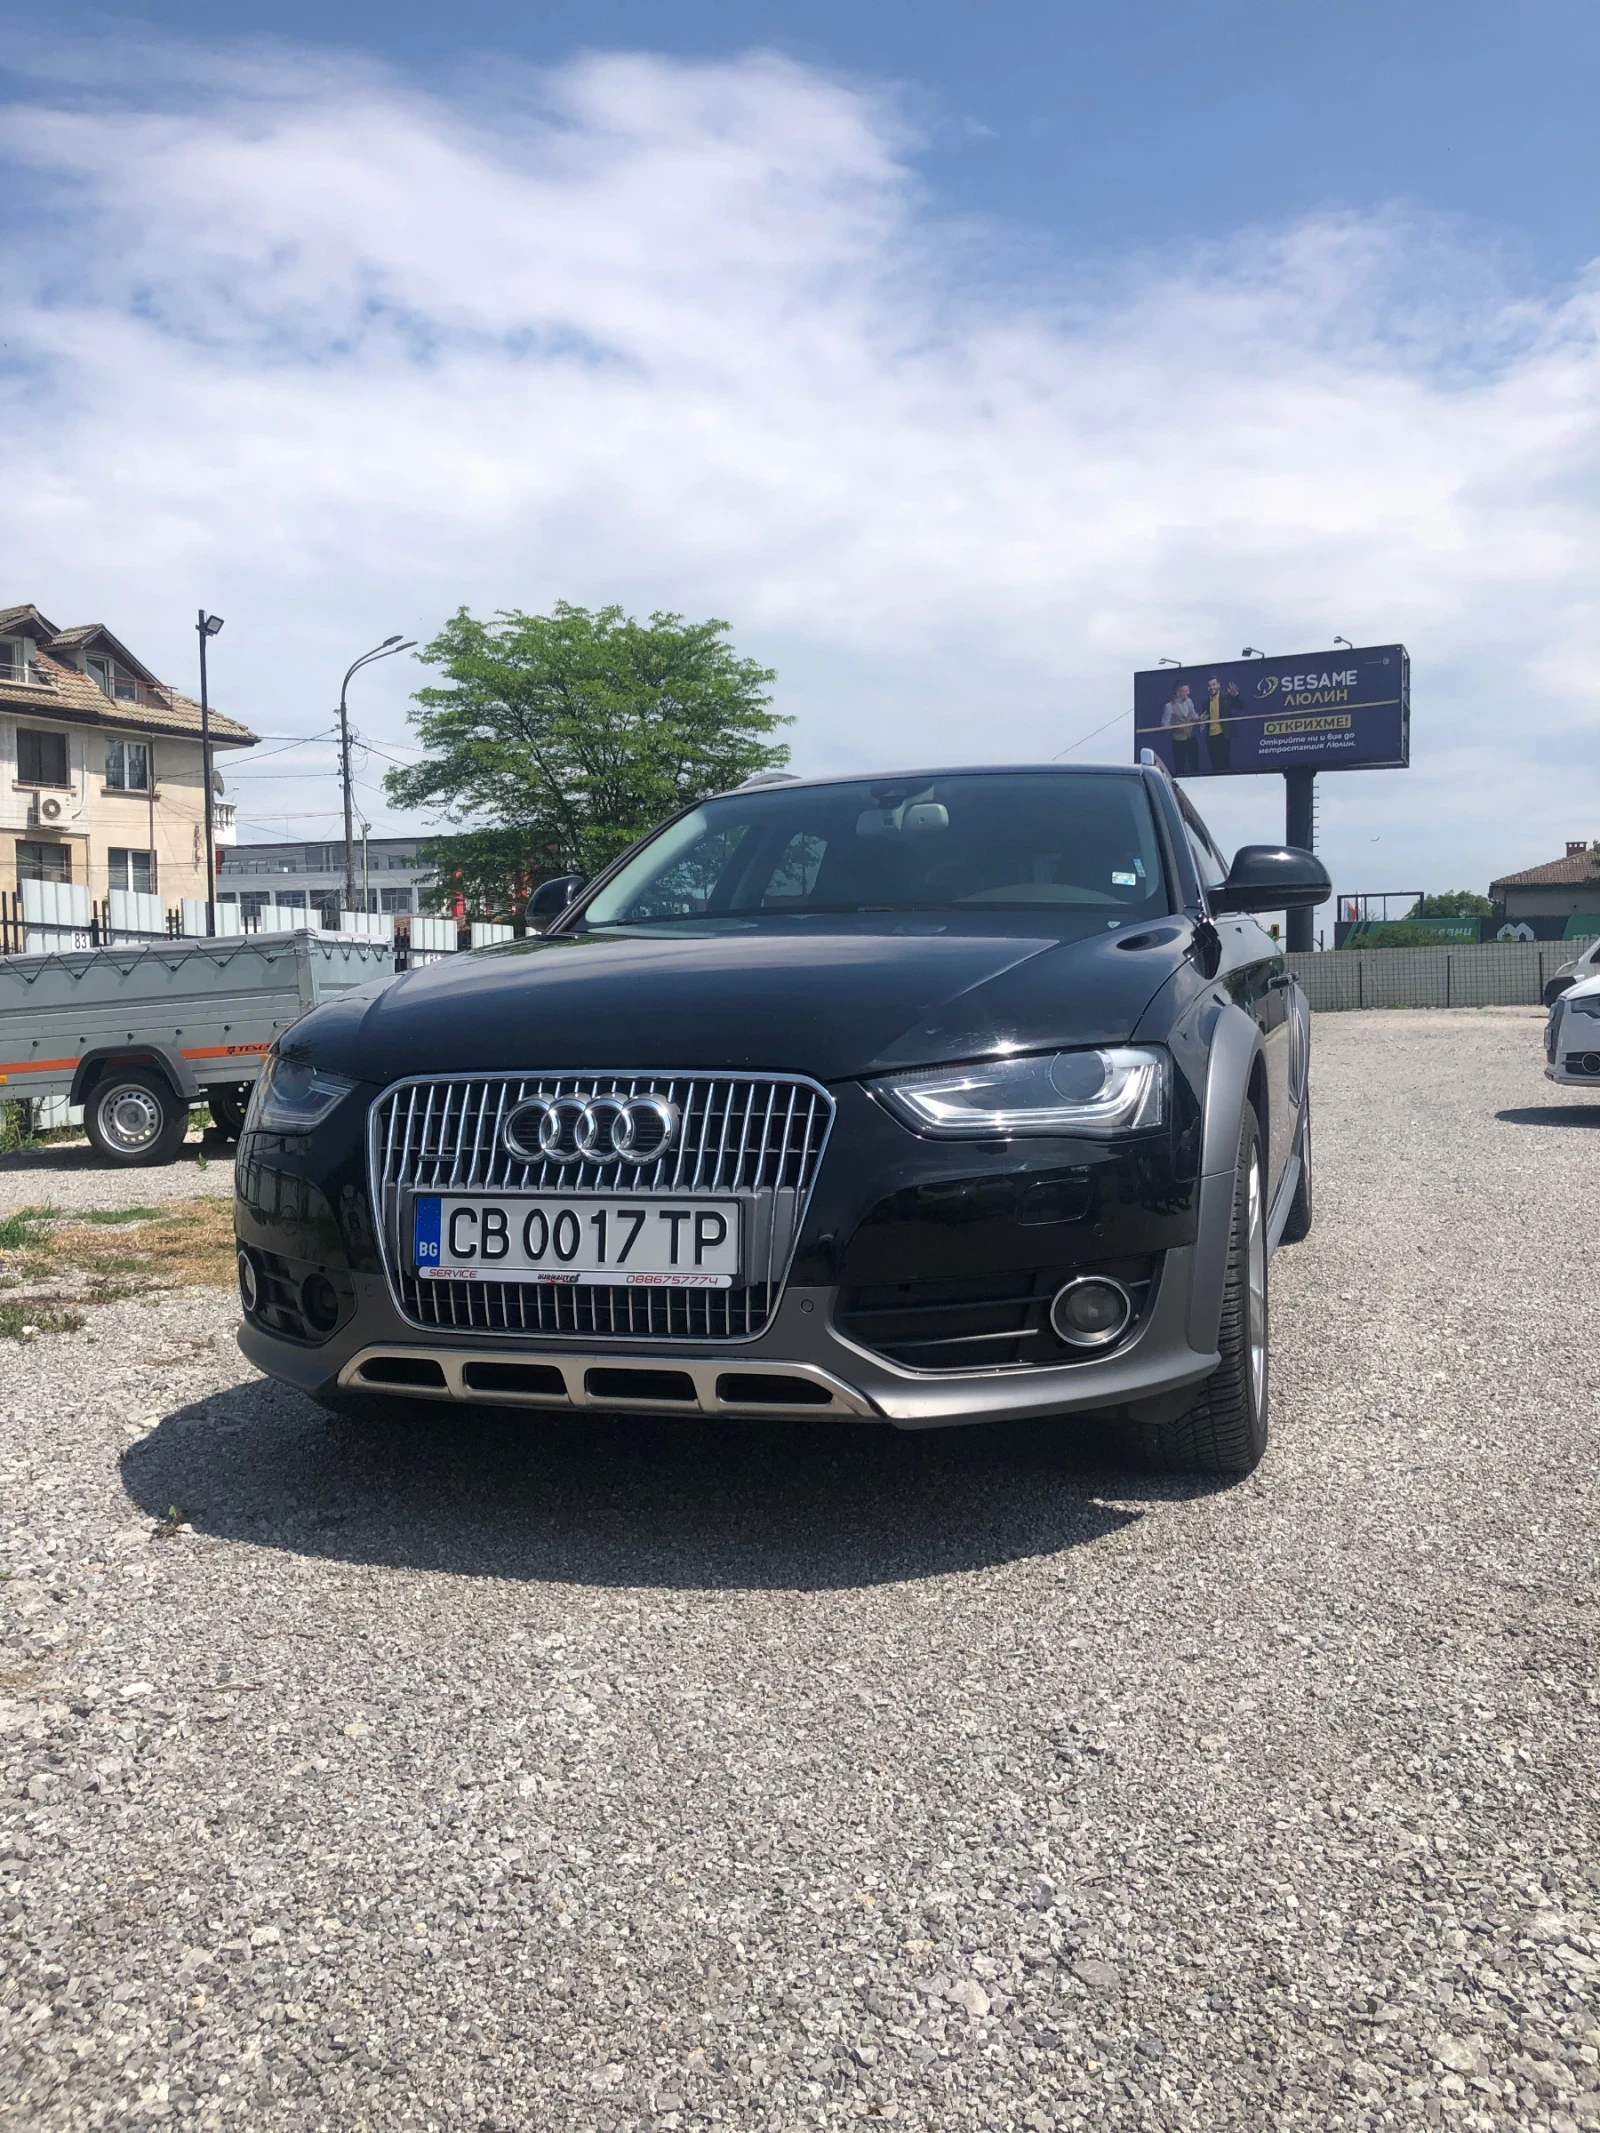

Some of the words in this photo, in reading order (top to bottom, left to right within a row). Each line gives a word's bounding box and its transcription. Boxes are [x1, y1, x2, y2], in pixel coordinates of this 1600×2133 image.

[1281, 670, 1358, 692] SESAME
[1284, 689, 1348, 706] ЛЮЛИН
[1265, 716, 1349, 733] ОТКРИХМЕ!
[1259, 736, 1306, 747] Открийте
[75, 932, 87, 949] 83
[449, 1207, 511, 1259] CB
[523, 1208, 646, 1263] 0017
[659, 1210, 728, 1265] TP
[419, 1241, 438, 1257] BG
[428, 1268, 478, 1279] SERVICE
[626, 1274, 718, 1285] 0886757774
